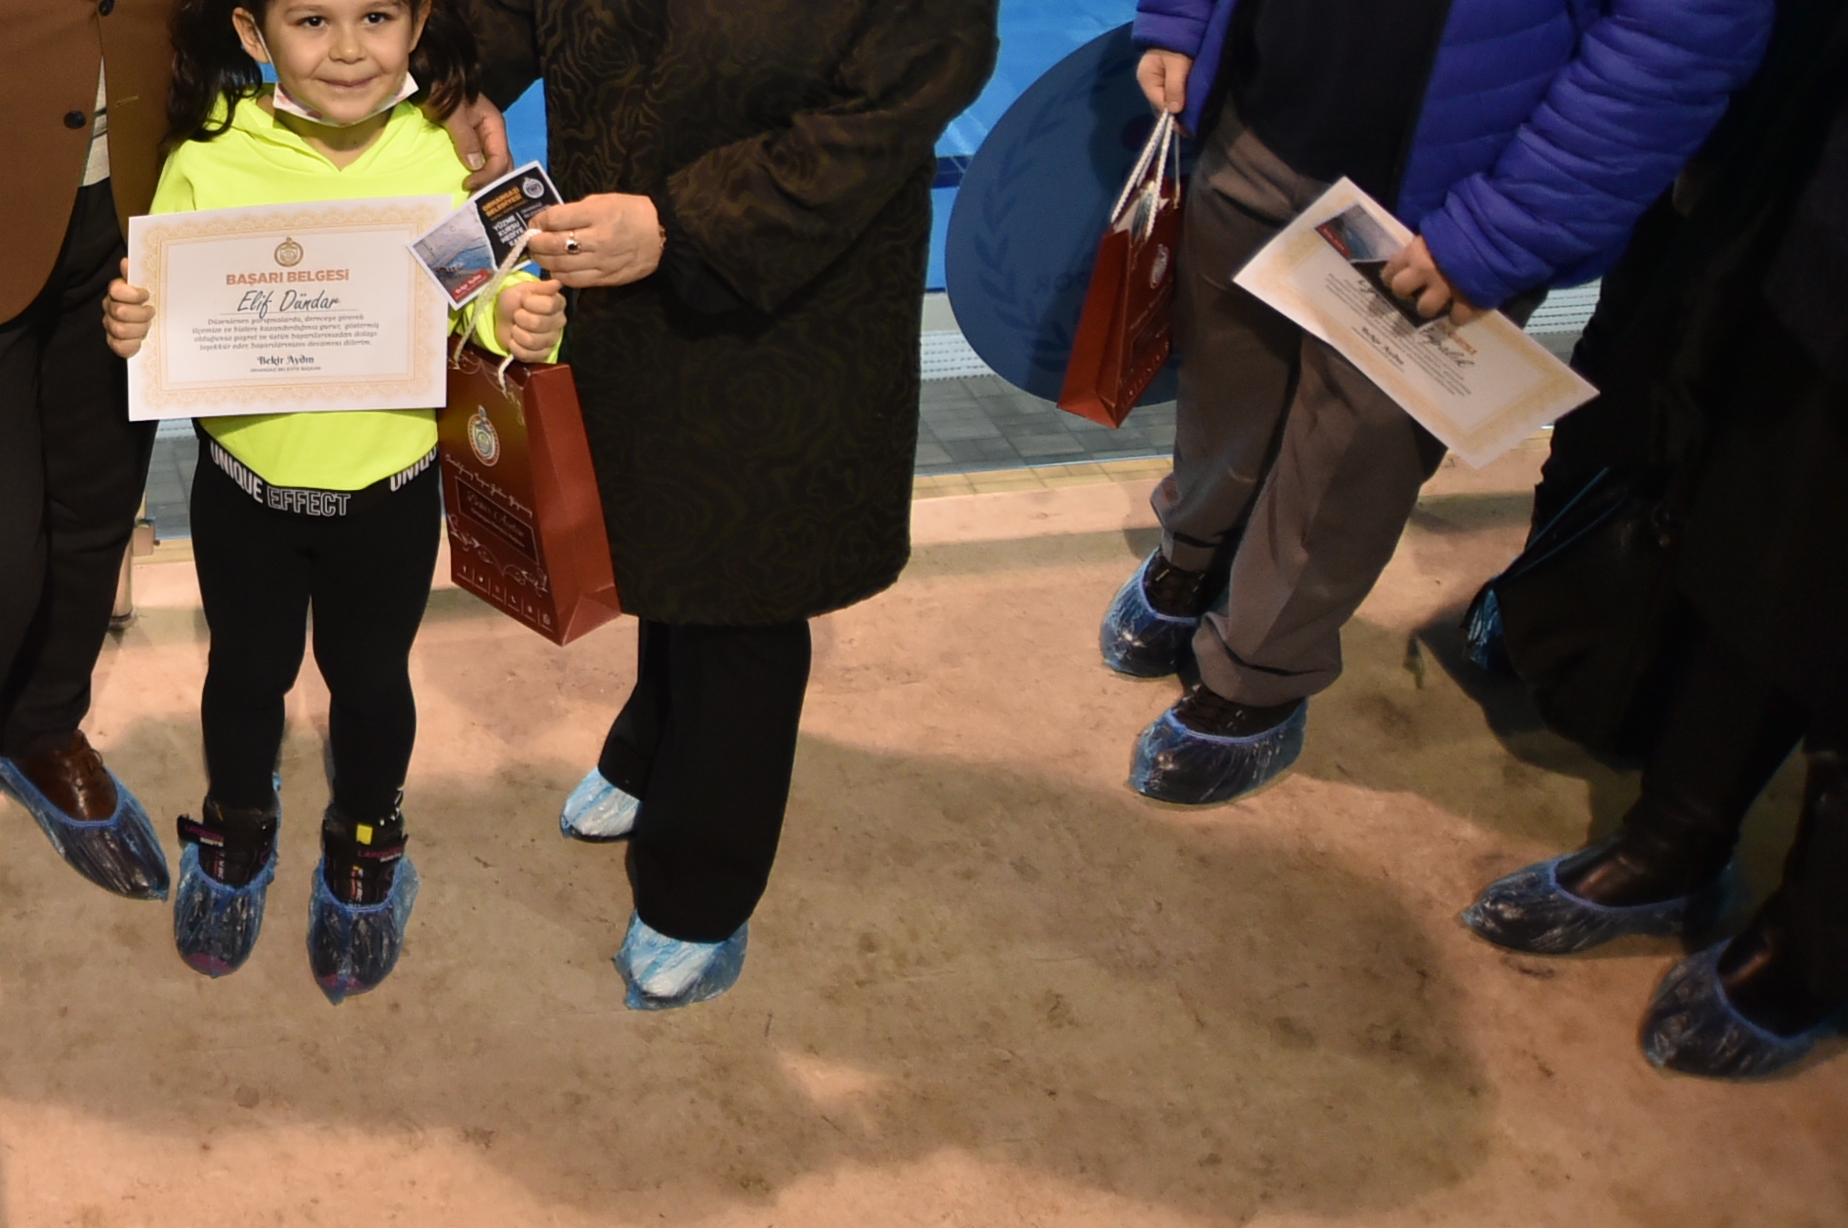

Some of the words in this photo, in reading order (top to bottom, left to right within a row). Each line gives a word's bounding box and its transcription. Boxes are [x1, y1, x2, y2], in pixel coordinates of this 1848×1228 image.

[226, 272, 283, 286] BAŞARI
[287, 269, 349, 283] BELGESİ
[237, 290, 274, 319] Elif
[279, 289, 340, 312] Dündar
[257, 356, 284, 366] Bekir
[287, 354, 314, 366] Aydın
[210, 440, 263, 504] UNIQUE
[266, 485, 351, 516] EFFECT
